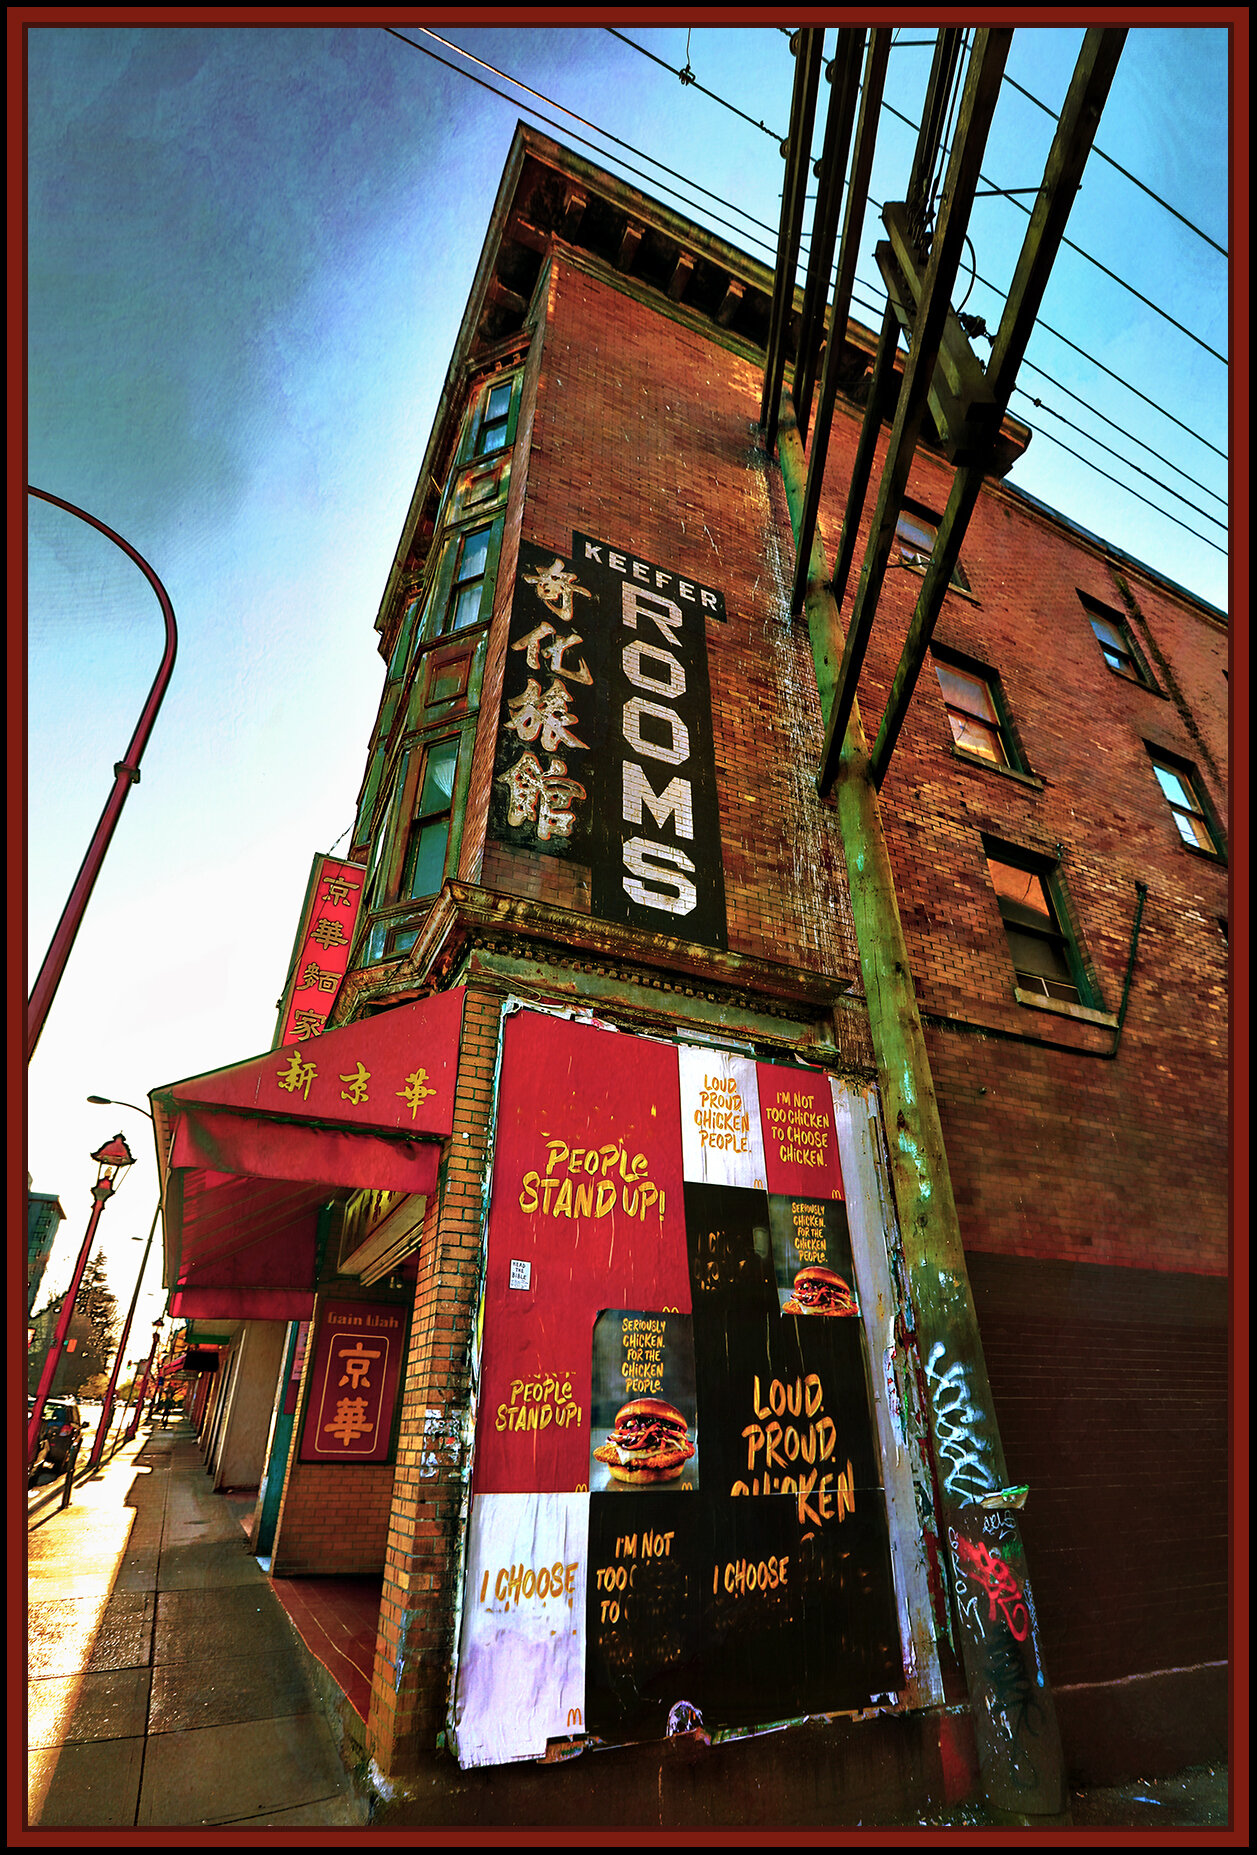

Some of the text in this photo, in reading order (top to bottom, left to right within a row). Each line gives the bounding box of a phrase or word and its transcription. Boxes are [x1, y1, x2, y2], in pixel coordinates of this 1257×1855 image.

[584, 541, 718, 612] KEEFER
[621, 580, 698, 917] ROOMS
[277, 1050, 437, 1120] 新京華
[704, 1074, 737, 1094] LOUD.
[699, 1091, 742, 1112] PROUD.
[766, 1107, 786, 1123] TOO
[777, 1091, 814, 1109] I'M NOT
[699, 1130, 752, 1153] PEOPLE.
[771, 1126, 828, 1148] TO CHOOSE
[519, 1171, 666, 1222] STAND UP!
[797, 1226, 823, 1238] FOR THE
[627, 1348, 661, 1362] FOR THE
[324, 1342, 381, 1447] 京華
[753, 1373, 824, 1420] LOUD.
[495, 1401, 582, 1432] STAND UP!
[741, 1416, 836, 1471] PROUD.
[615, 1527, 675, 1559] I'M NOT
[479, 1561, 579, 1607] I CHOOSE
[596, 1565, 628, 1592] TOO
[713, 1555, 790, 1596] I CHOOSE
[600, 1600, 620, 1624] TO
